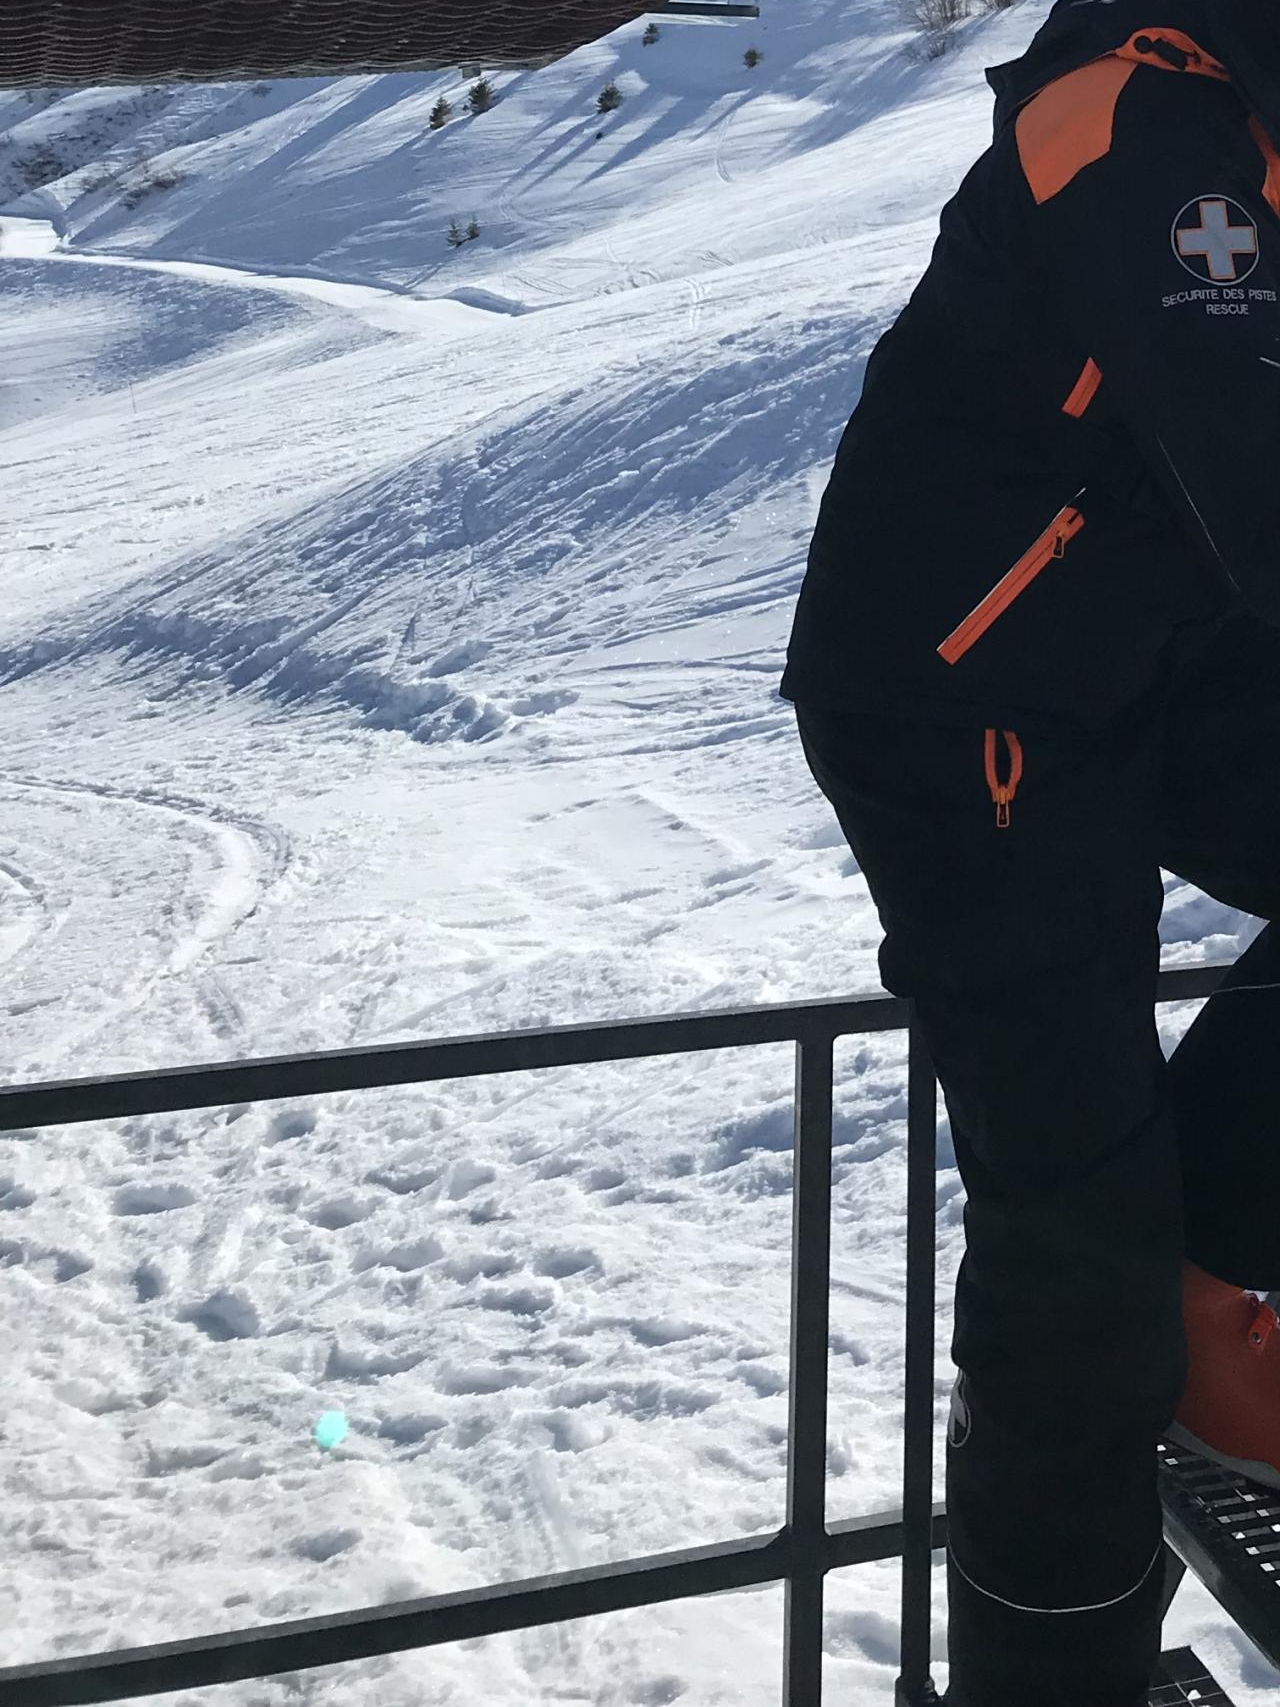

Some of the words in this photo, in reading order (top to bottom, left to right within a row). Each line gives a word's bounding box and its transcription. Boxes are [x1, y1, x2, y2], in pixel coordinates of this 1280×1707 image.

[1161, 289, 1219, 307] SECURITE
[1223, 288, 1245, 300] DES
[1206, 304, 1249, 315] RESCUE
